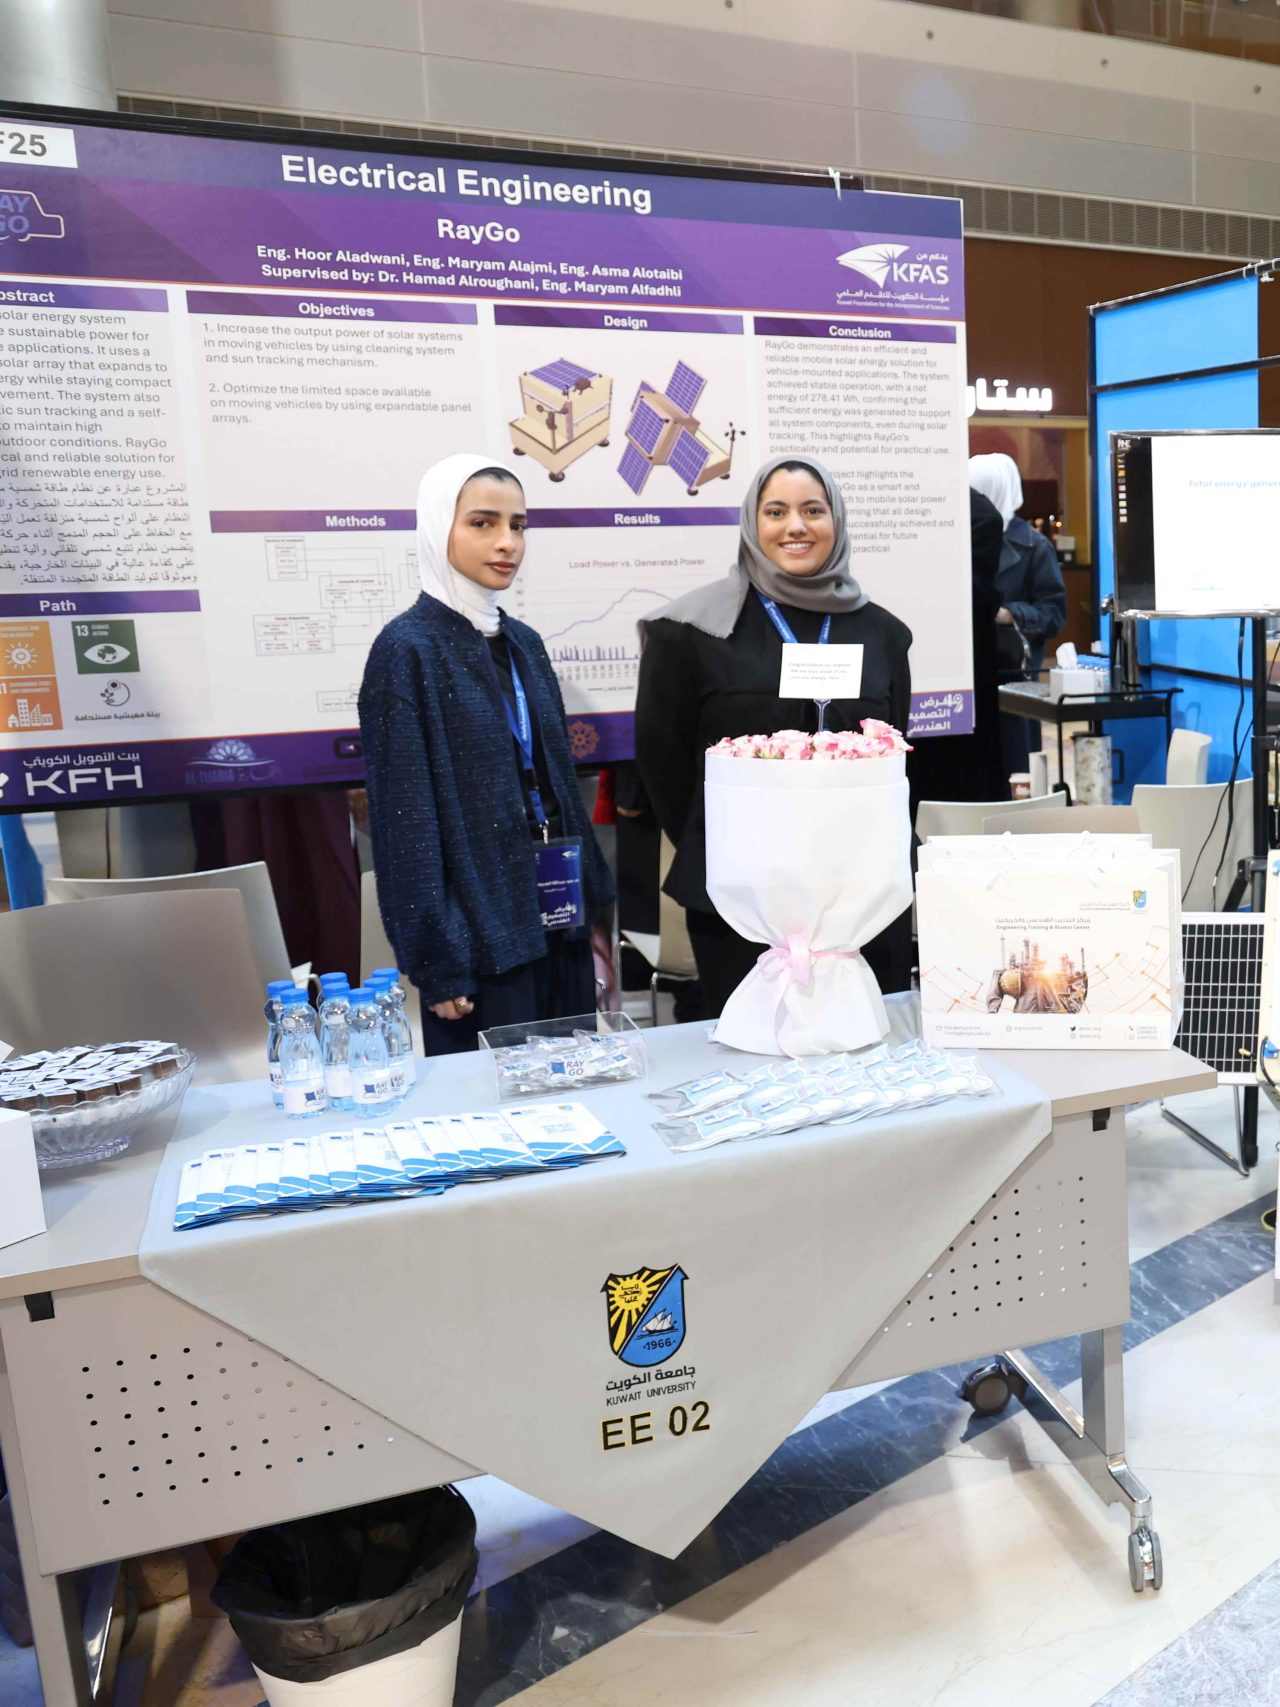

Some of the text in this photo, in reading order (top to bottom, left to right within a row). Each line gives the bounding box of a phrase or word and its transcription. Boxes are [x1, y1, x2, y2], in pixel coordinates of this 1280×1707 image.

[281, 155, 651, 213] Electrical Engineering
[437, 218, 520, 244] RayGo
[256, 245, 682, 280] Eng. Hoor Aladwani, Eng. Maryam Alajmi, Eng. Asma Alotaibi
[928, 253, 948, 262] بدعم
[261, 264, 681, 296] Supervised by: Dr. Hamad Alroughani, Eng. Maryam Alfadhli
[892, 262, 949, 284] KFAS
[298, 302, 375, 316] Objectives
[32, 313, 126, 325] energy system
[604, 315, 648, 329] Design
[7, 328, 149, 340] sustainable power for
[203, 322, 463, 341] 1. Increase the output power of solar systems
[828, 325, 891, 338] Conclusion
[7, 343, 150, 356] applications. It uses a
[203, 339, 455, 356] in moving vehicles by using cleaning system
[764, 340, 795, 350] RayGo
[796, 342, 860, 352] demonstrates
[873, 345, 909, 354] efficient
[32, 360, 167, 372] array that expands to
[205, 354, 377, 367] and sun tracking mechanism.
[26, 374, 172, 388] while staying compact
[208, 382, 431, 396] 2. Optimize the limited space available
[209, 399, 472, 412] on moving vehicles by using expandable panel
[212, 414, 252, 424] arrays.
[325, 515, 386, 527] Methods
[614, 513, 660, 525] Results
[39, 600, 76, 612] Path
[75, 625, 89, 637] 13
[23, 752, 140, 768] بيت التمويل الكويتي
[25, 765, 143, 796] KFH
[566, 1060, 585, 1068] RAY
[568, 1068, 584, 1076] GO
[645, 1338, 672, 1350] 1966
[606, 1366, 696, 1392] جامعة الكويت
[606, 1381, 696, 1406] KUWAIT UNIVERSITY
[602, 1400, 710, 1450] EE 02
